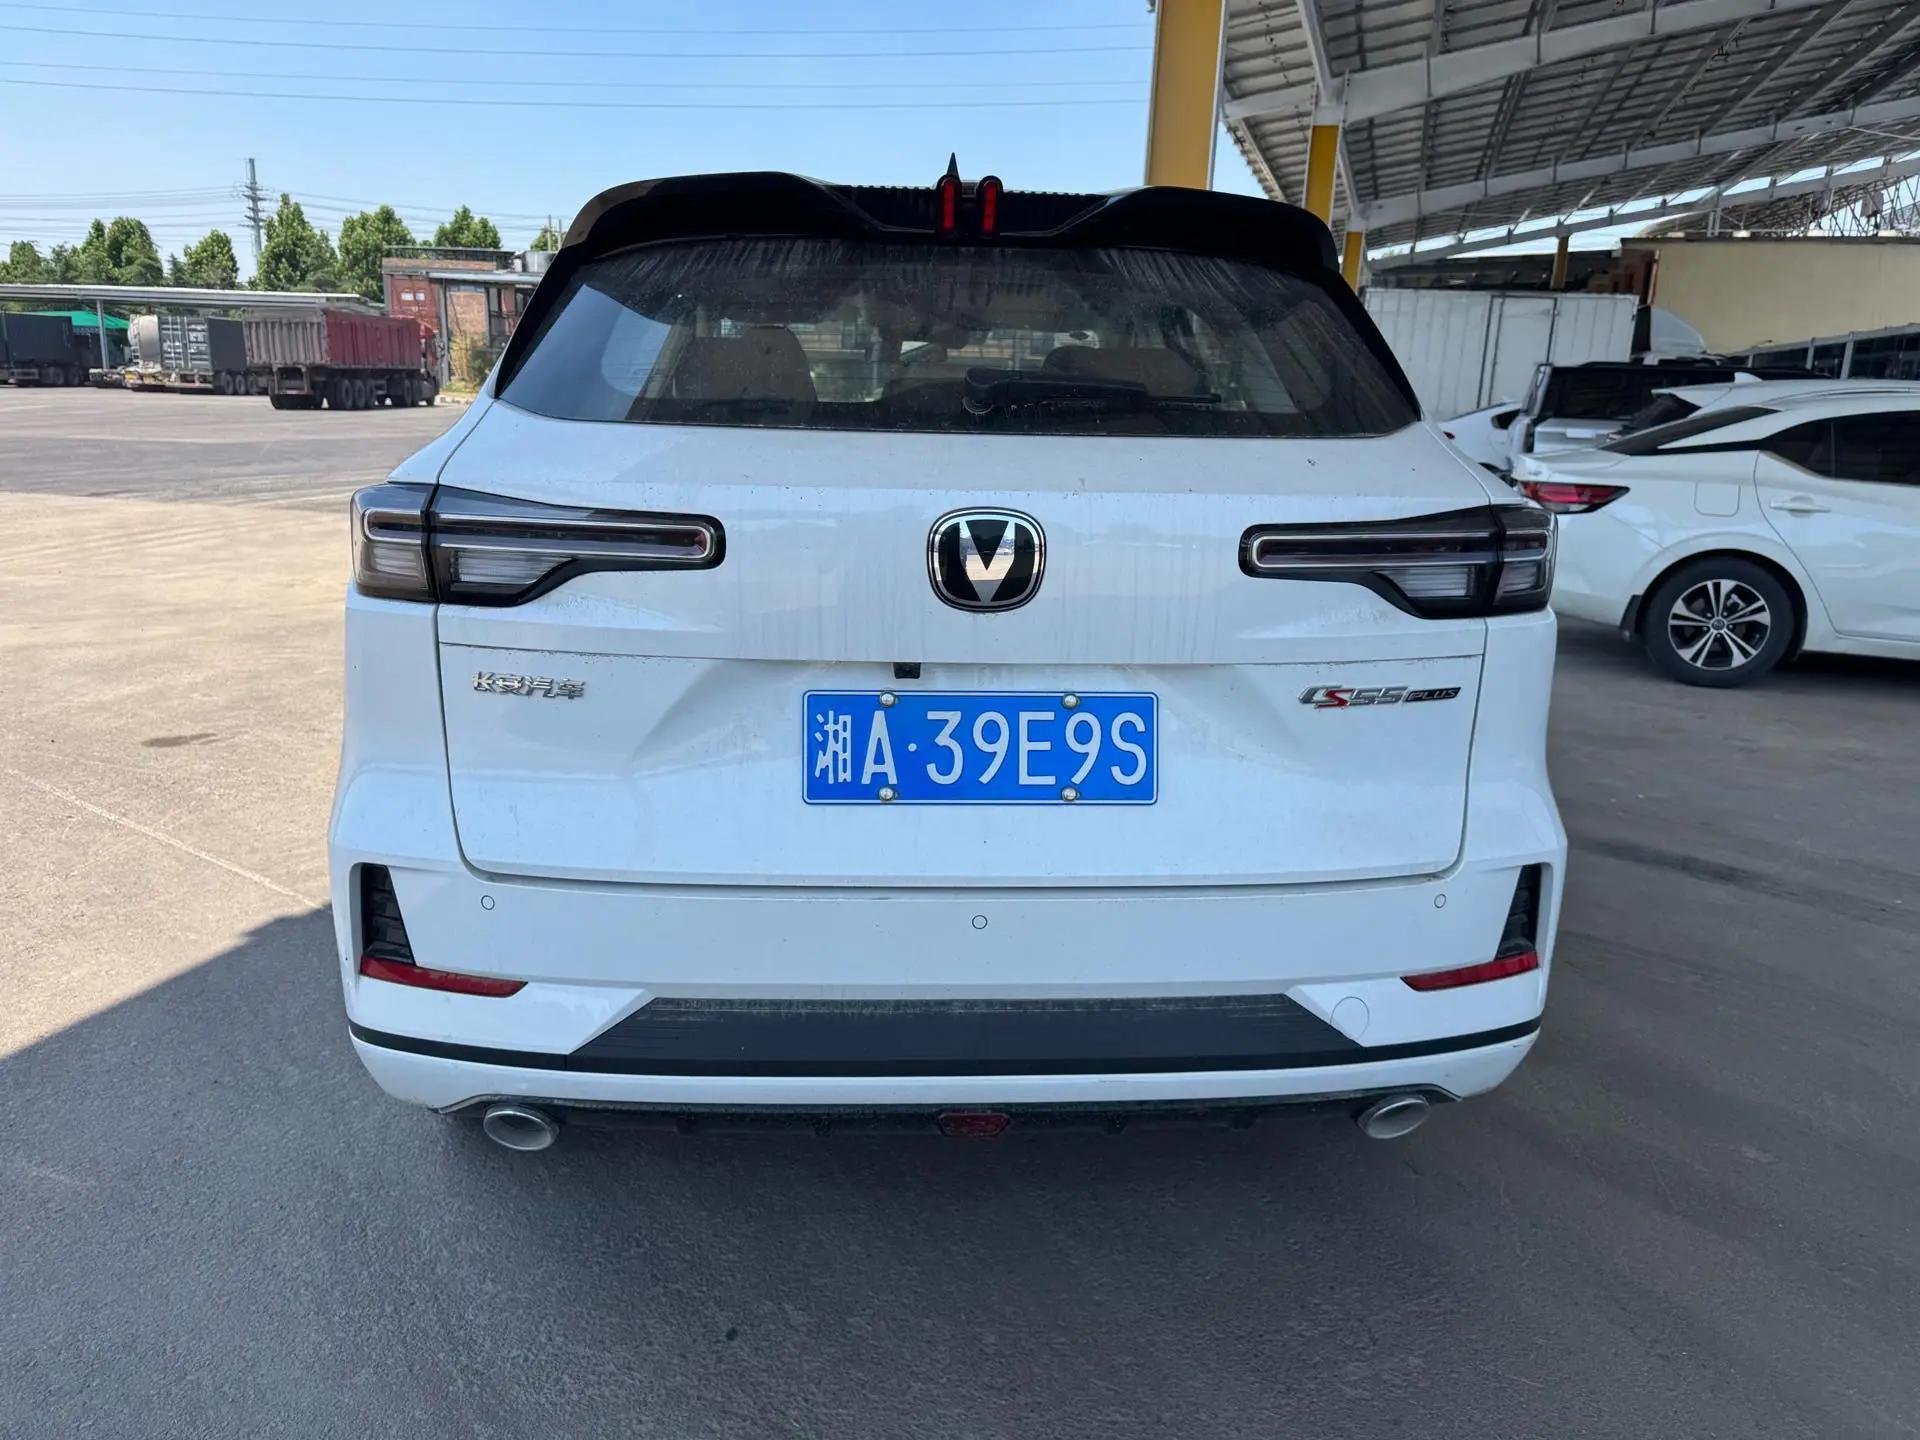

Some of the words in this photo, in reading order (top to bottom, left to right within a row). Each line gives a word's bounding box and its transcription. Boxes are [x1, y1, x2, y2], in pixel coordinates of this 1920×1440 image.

[1298, 684, 1408, 709] CS55
[1407, 688, 1459, 701] PLUS
[814, 710, 1147, 785] 湘A·39E9S
